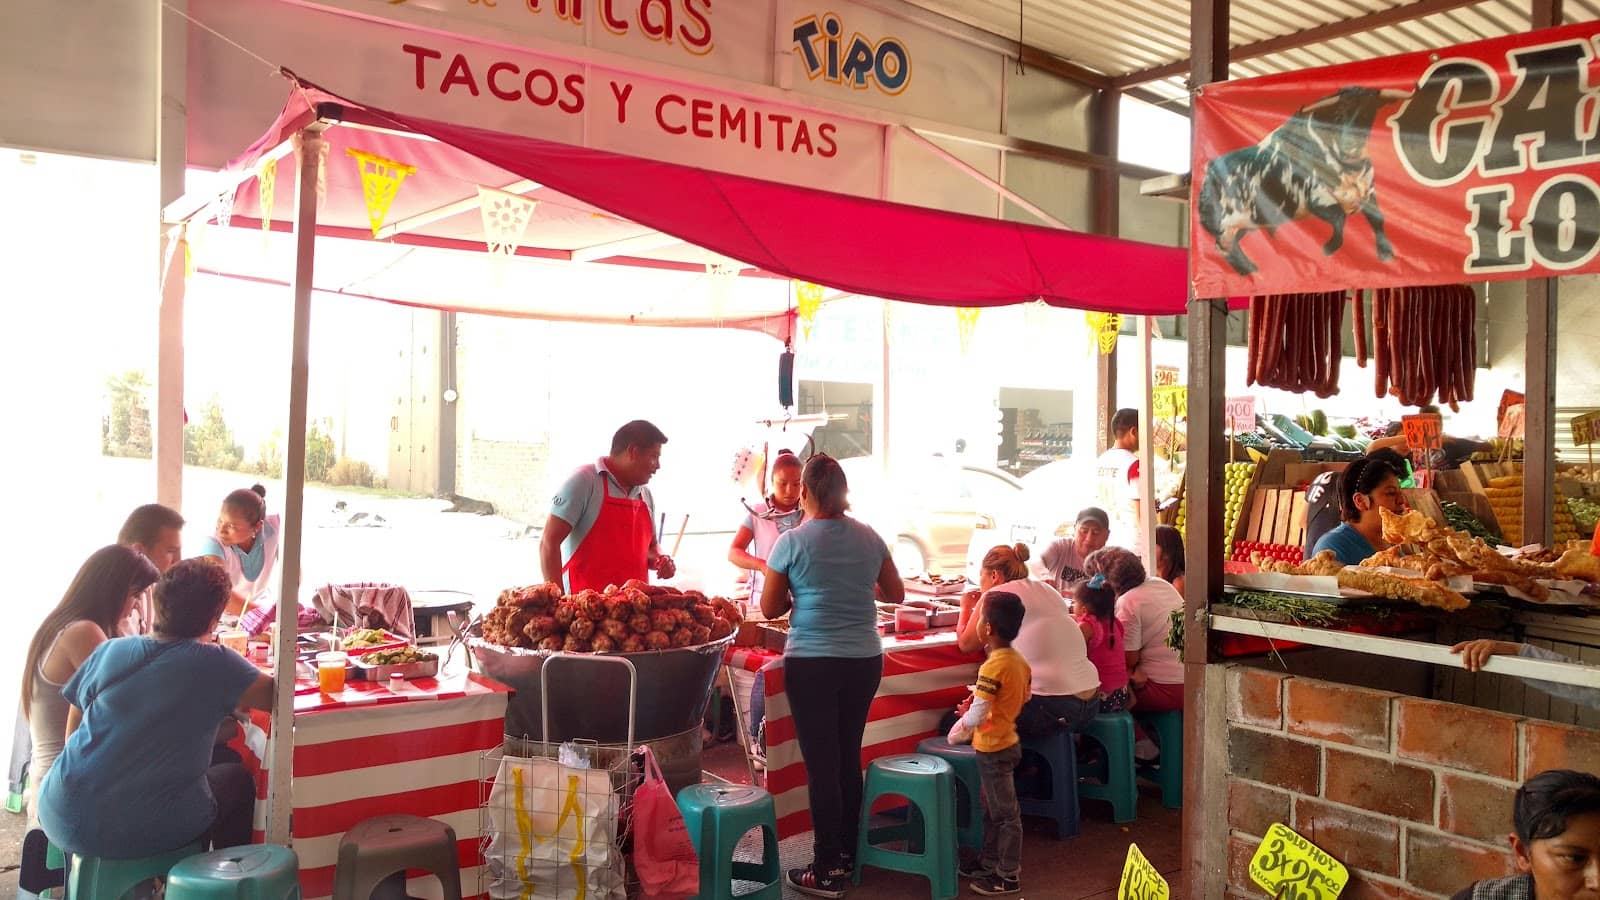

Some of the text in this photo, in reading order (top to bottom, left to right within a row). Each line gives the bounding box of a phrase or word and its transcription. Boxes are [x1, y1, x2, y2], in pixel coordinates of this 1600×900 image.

[402, 44, 838, 157] TACOS Y CEMITAS
[1387, 35, 1600, 188] CA
[1274, 825, 1338, 871] SOLO HOY
